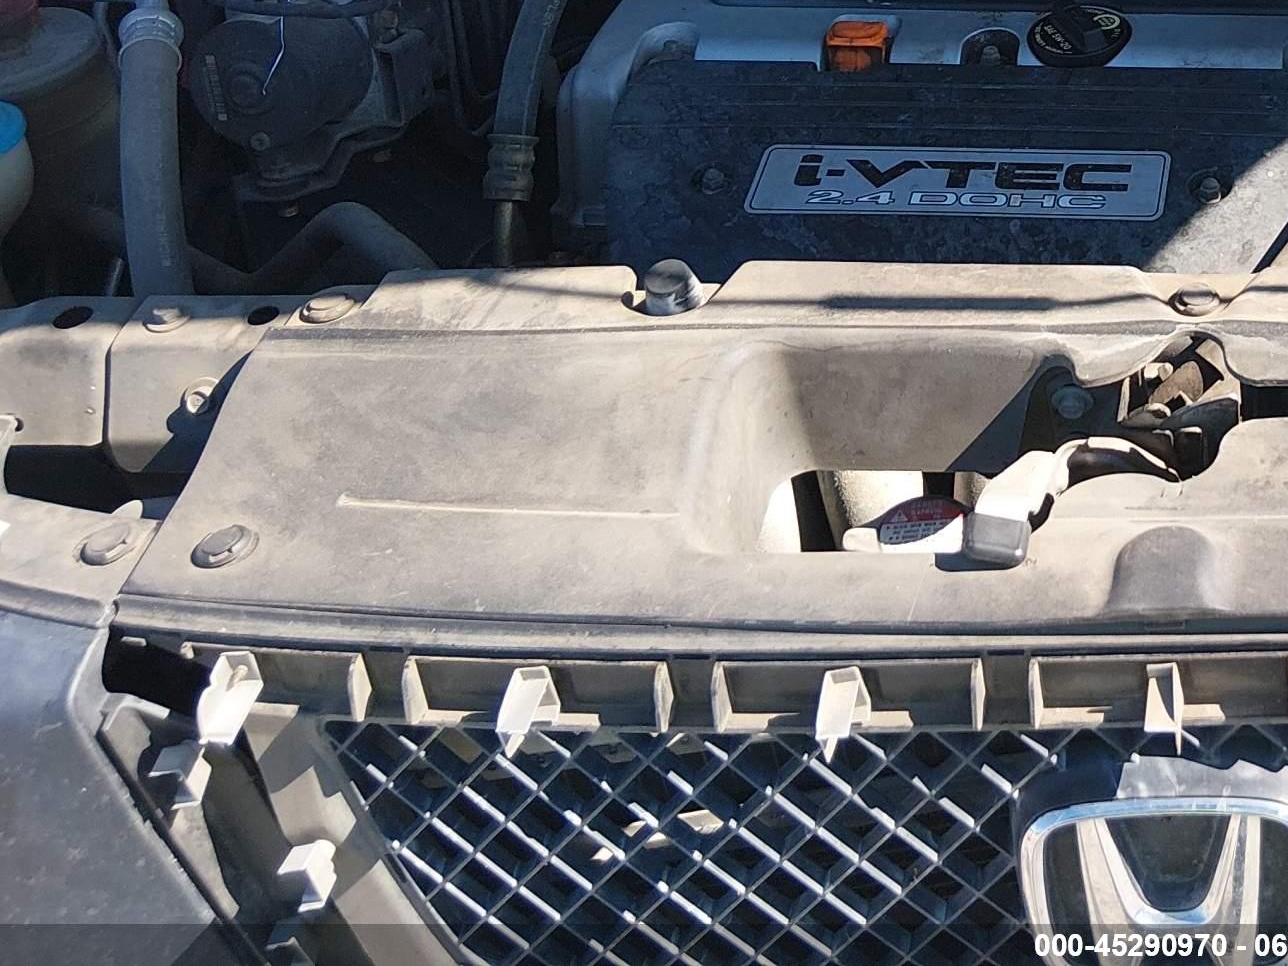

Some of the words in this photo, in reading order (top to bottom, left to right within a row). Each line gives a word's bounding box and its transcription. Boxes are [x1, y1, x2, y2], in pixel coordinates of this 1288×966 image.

[793, 154, 1133, 191] i-VTEC
[804, 189, 897, 206] 2.4
[907, 191, 1107, 210] DOHC
